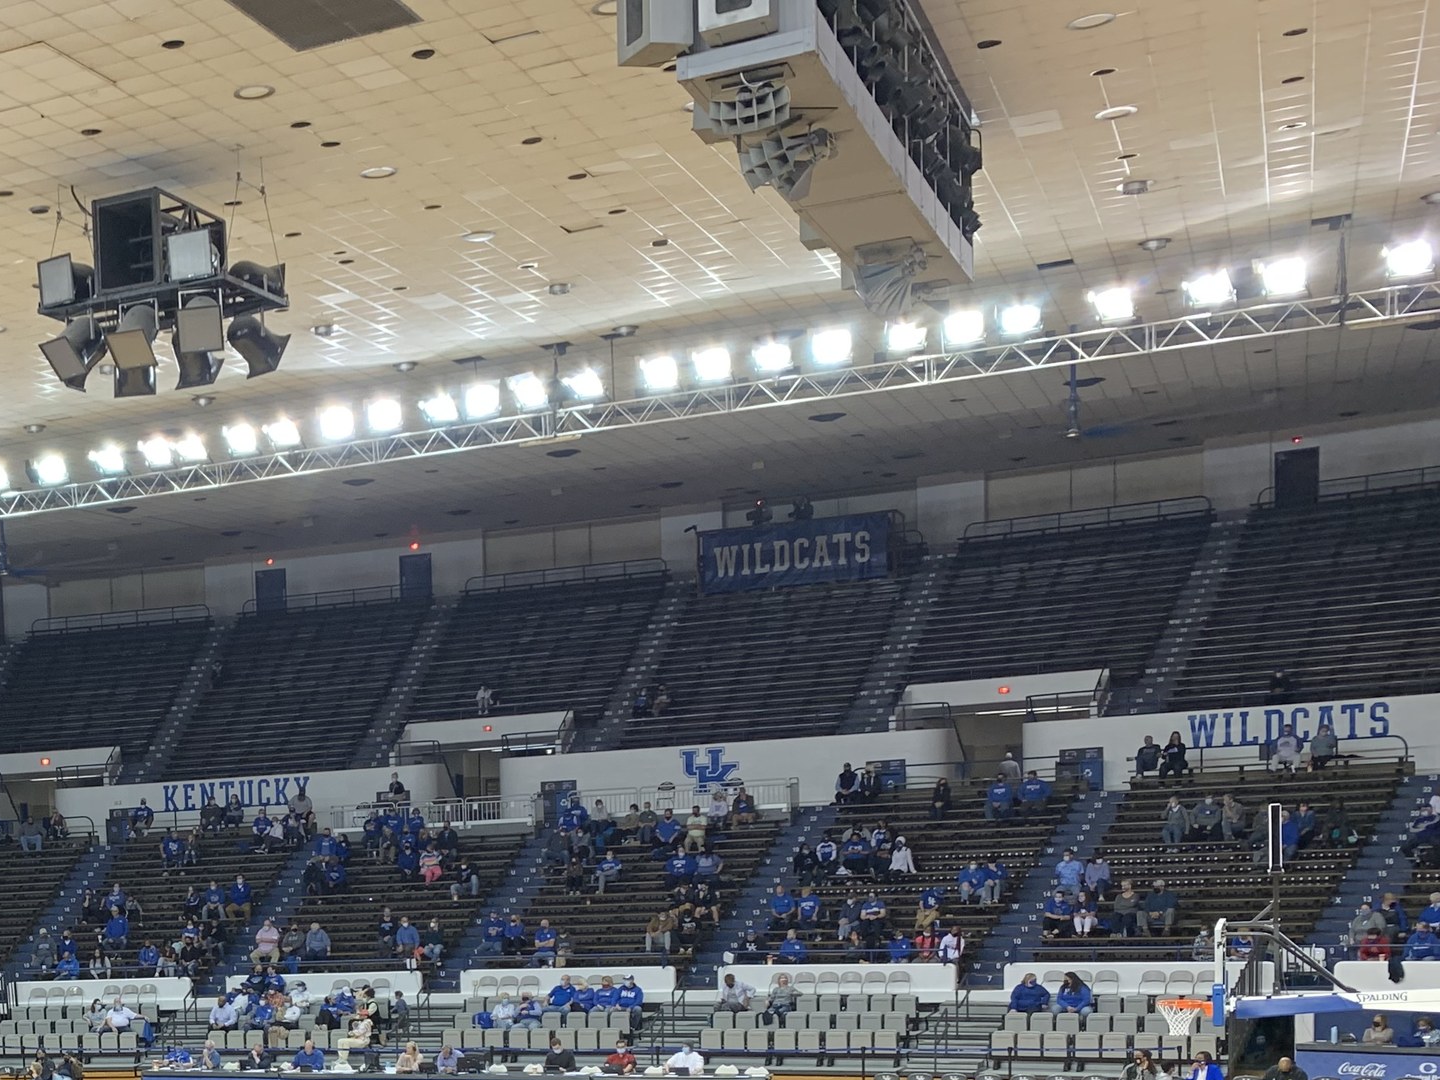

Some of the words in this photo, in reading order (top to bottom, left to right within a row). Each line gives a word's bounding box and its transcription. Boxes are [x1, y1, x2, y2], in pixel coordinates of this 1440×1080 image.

[714, 531, 871, 578] WILDCATS
[1187, 702, 1390, 749] WILDCATS
[162, 776, 311, 812] KENTUCKY
[680, 746, 739, 796] UK
[1356, 992, 1408, 1002] SPALDING
